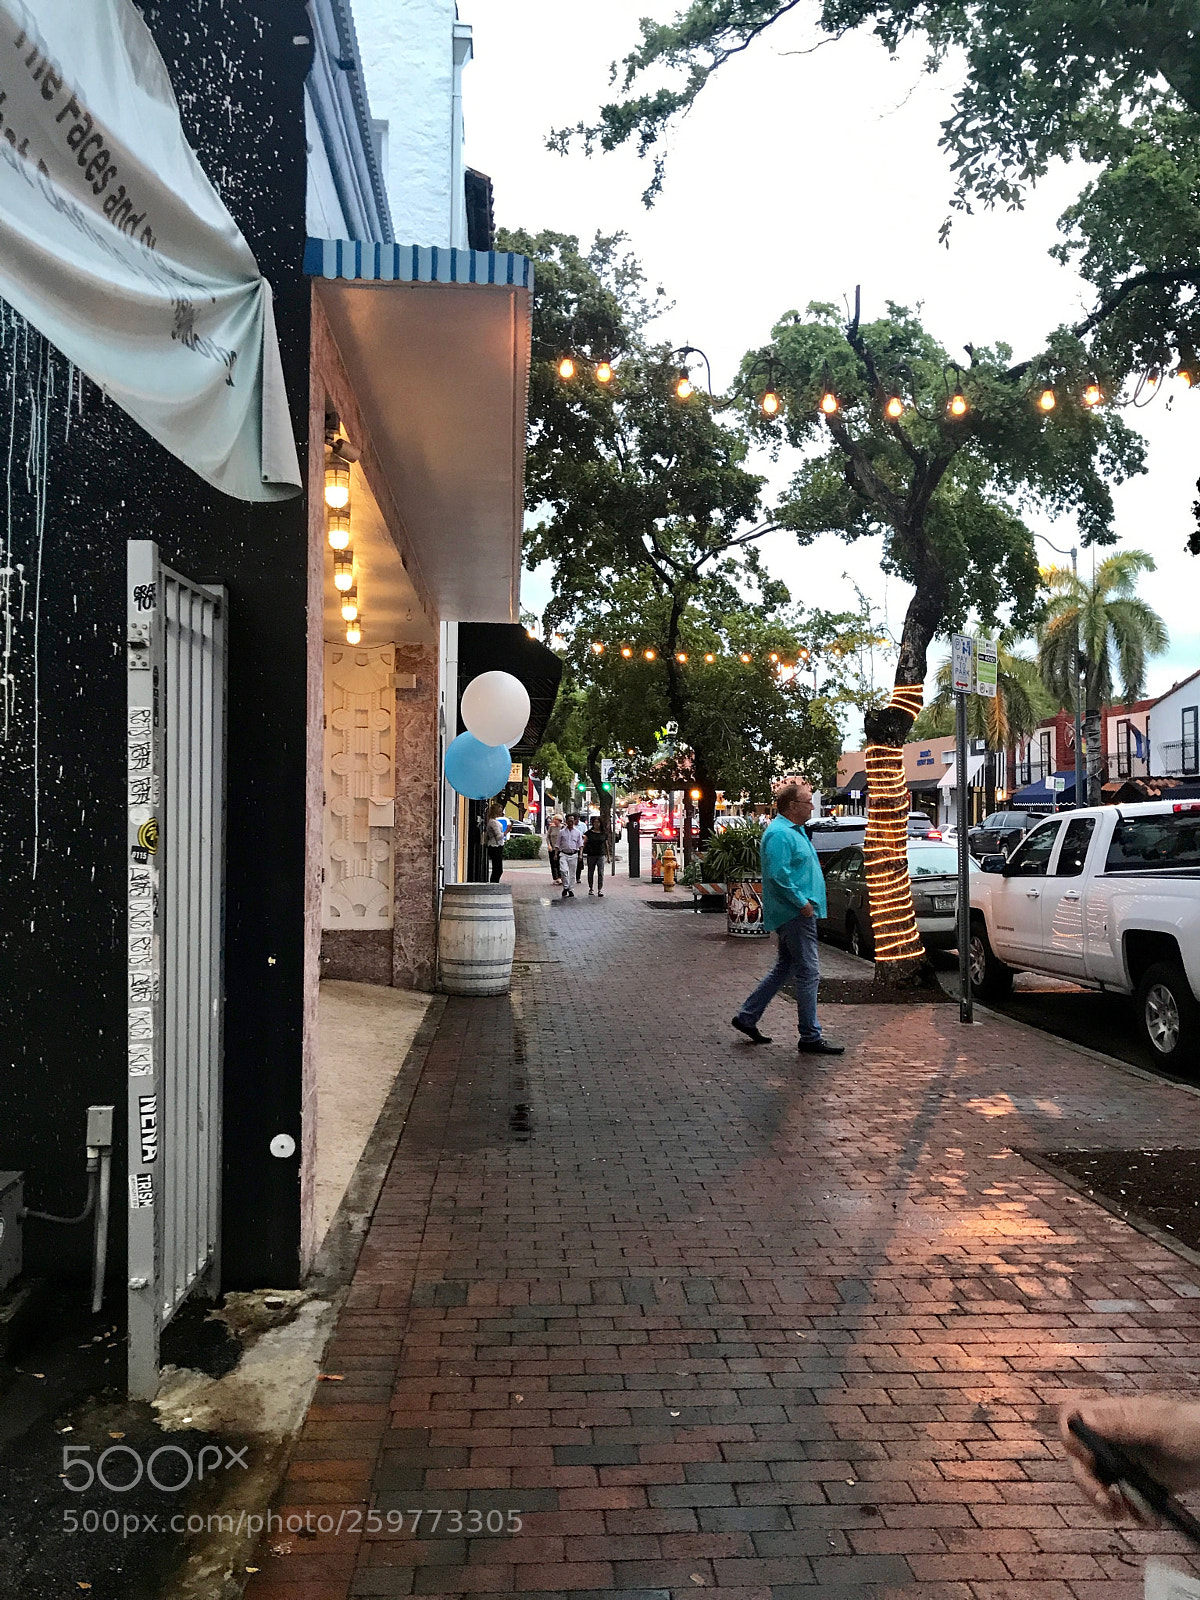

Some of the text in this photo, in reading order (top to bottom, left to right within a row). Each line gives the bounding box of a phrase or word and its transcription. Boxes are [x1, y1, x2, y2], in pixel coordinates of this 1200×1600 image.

[56, 94, 117, 195] races
[103, 185, 147, 237] and
[955, 667, 969, 675] PARK
